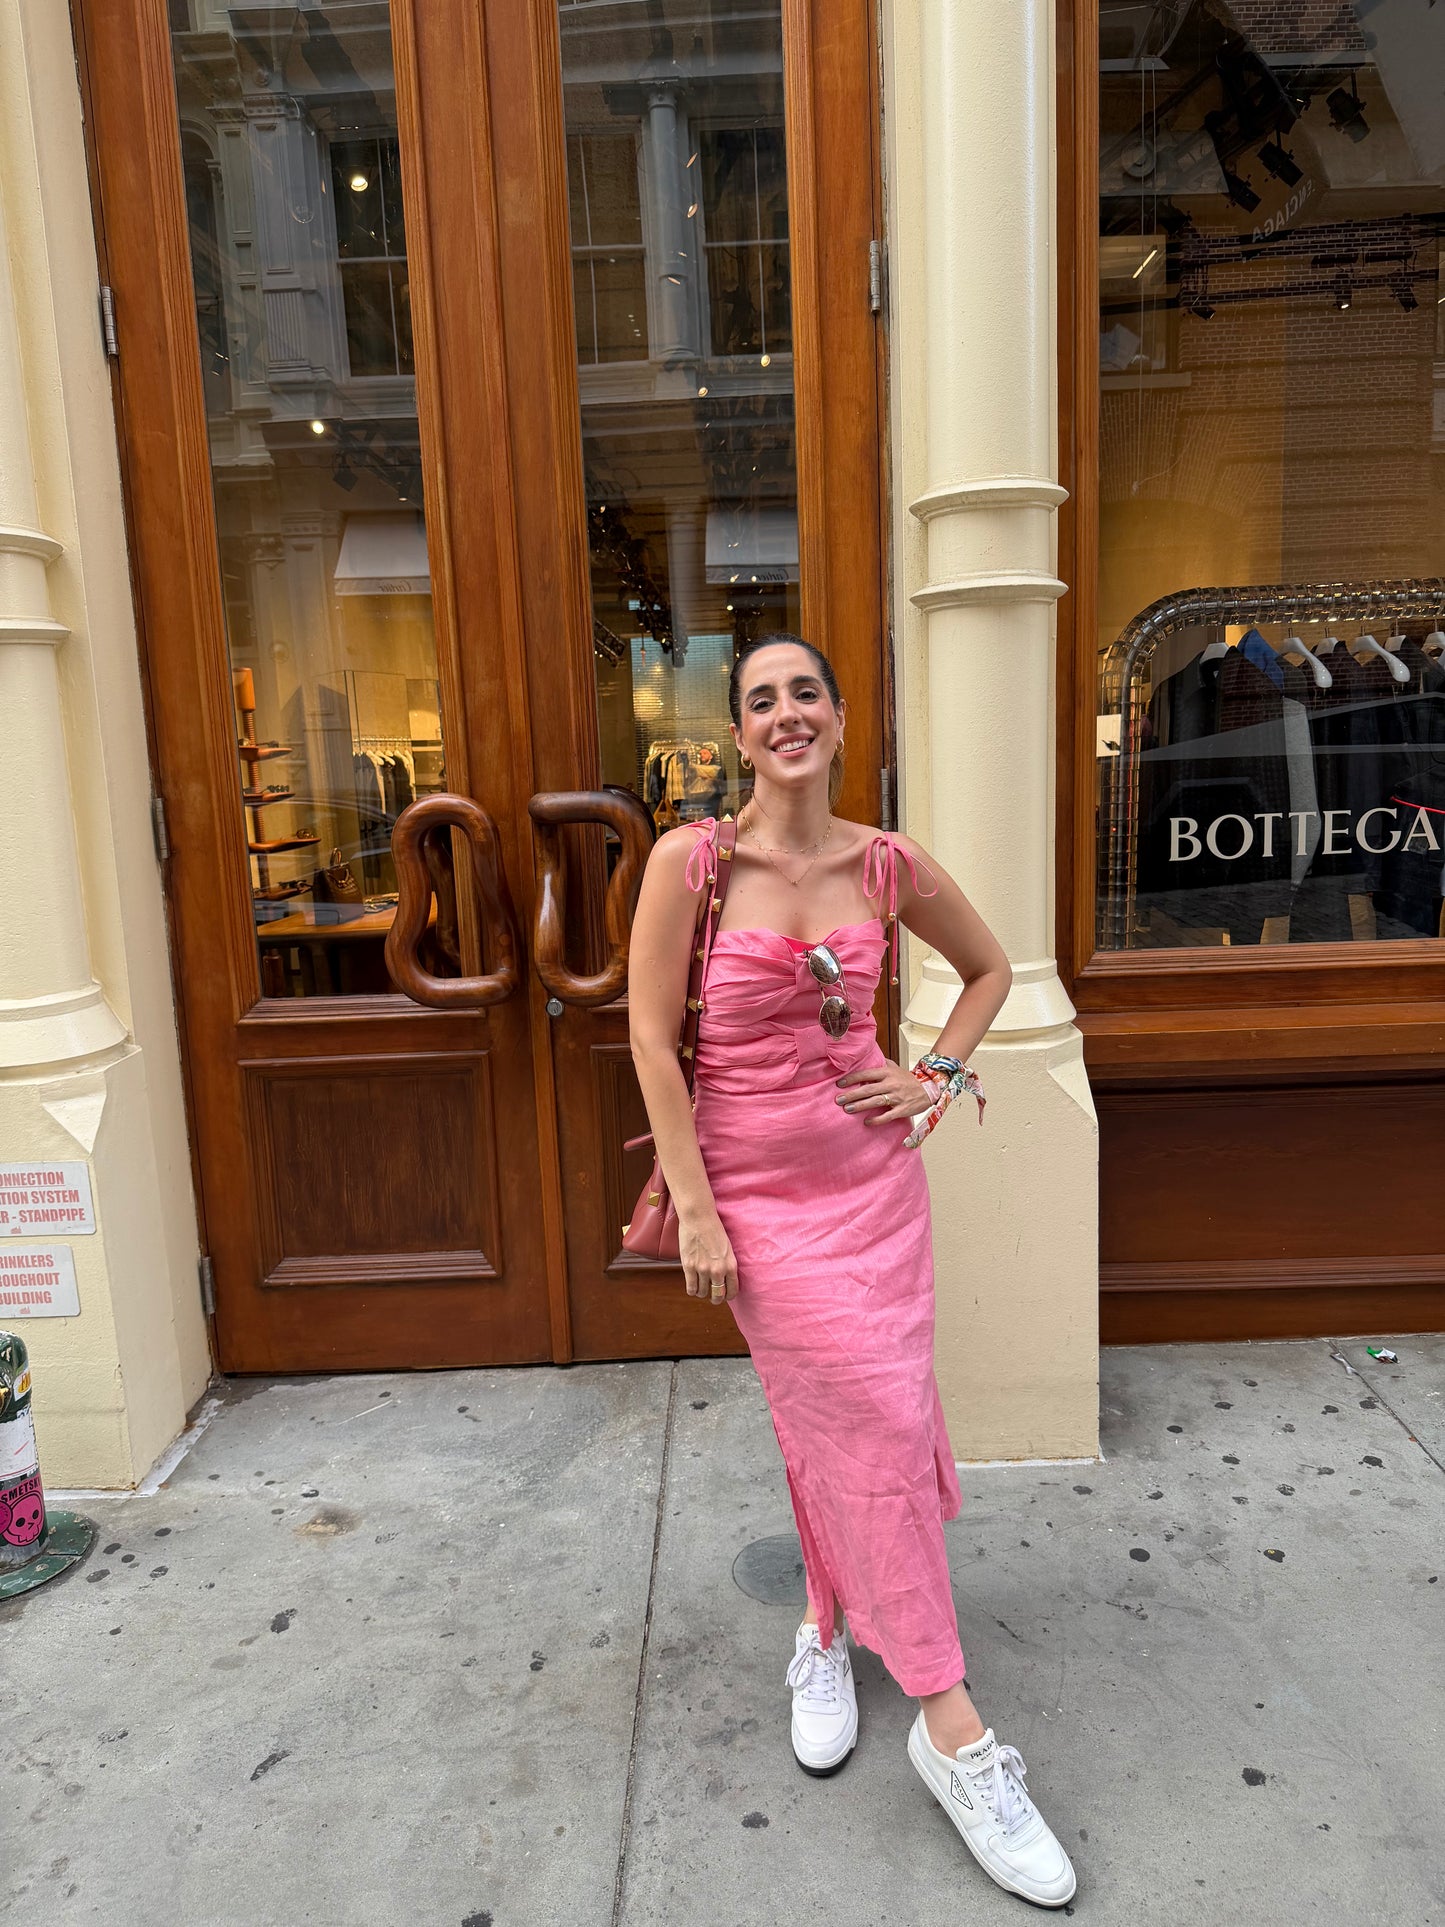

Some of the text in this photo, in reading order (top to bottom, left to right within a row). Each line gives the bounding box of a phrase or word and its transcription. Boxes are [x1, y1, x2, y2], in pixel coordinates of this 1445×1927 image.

[1169, 807, 1441, 862] BOTTEGA
[0, 1189, 80, 1205] TION SYSTEM
[0, 1210, 10, 1224] R
[19, 1208, 86, 1223] STANDPIPE
[0, 1272, 60, 1288] OUGHOUT
